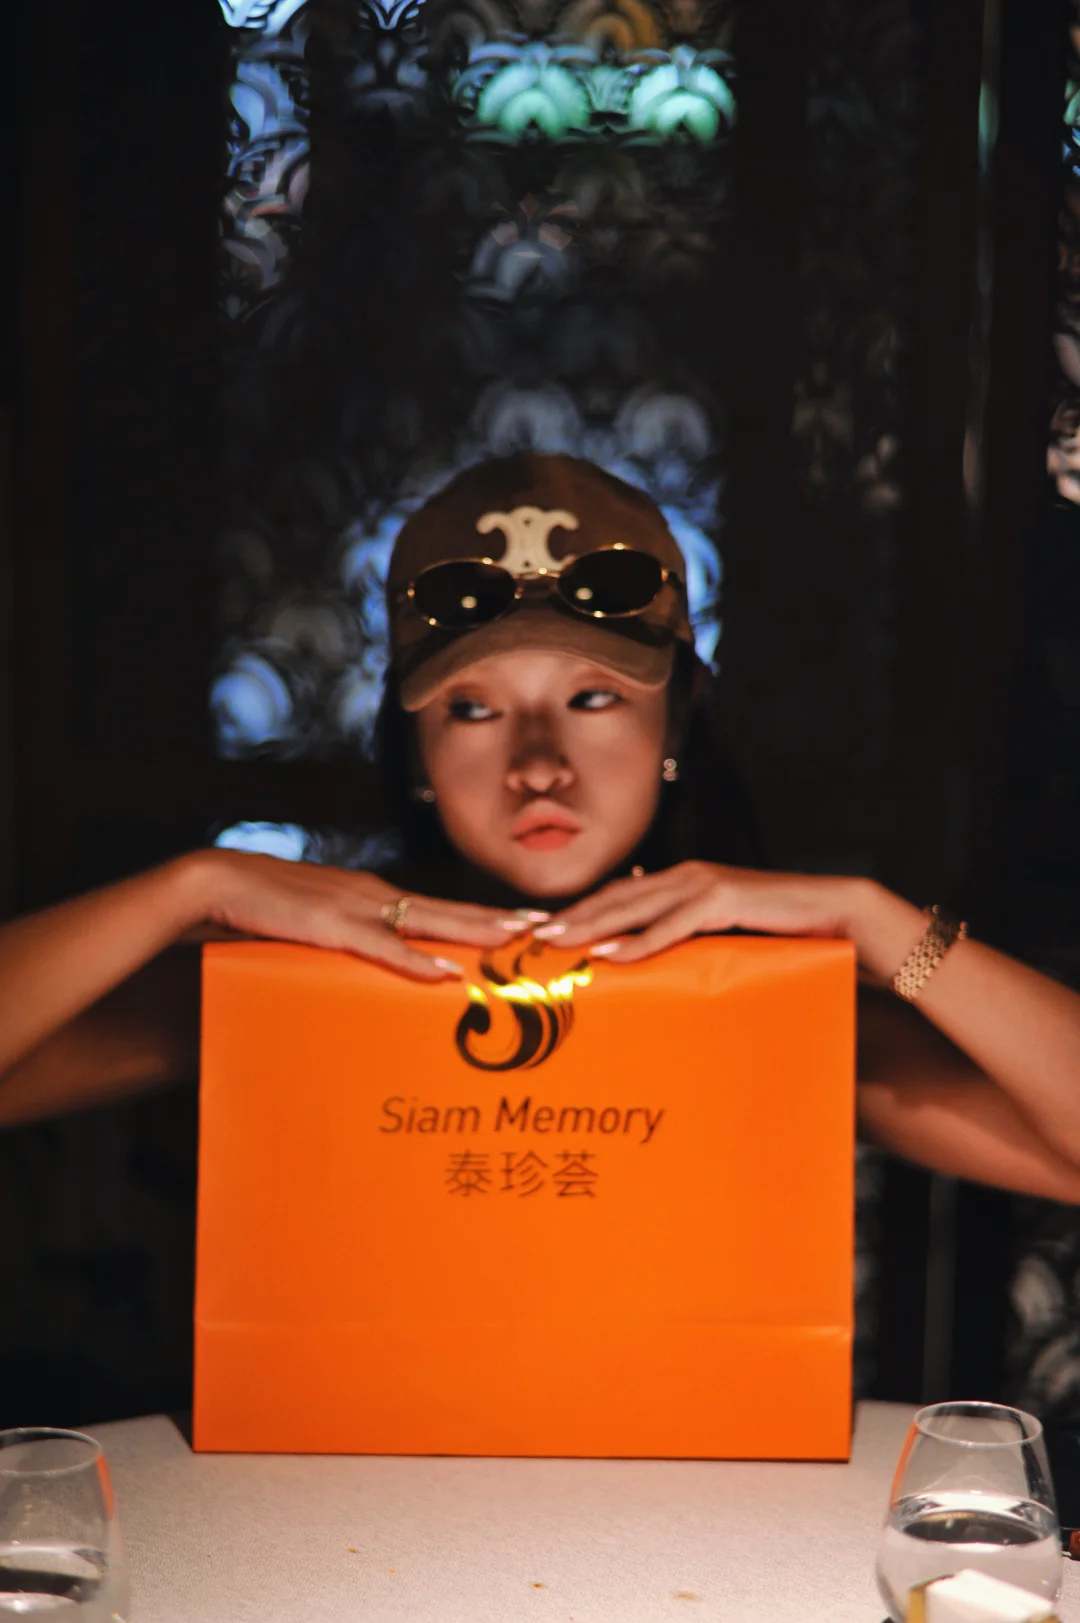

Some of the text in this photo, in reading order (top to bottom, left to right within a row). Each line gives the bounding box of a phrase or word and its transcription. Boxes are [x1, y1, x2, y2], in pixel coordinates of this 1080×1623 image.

[379, 1096, 665, 1144] Siam Memory
[445, 1150, 599, 1198] 泰珍荟
